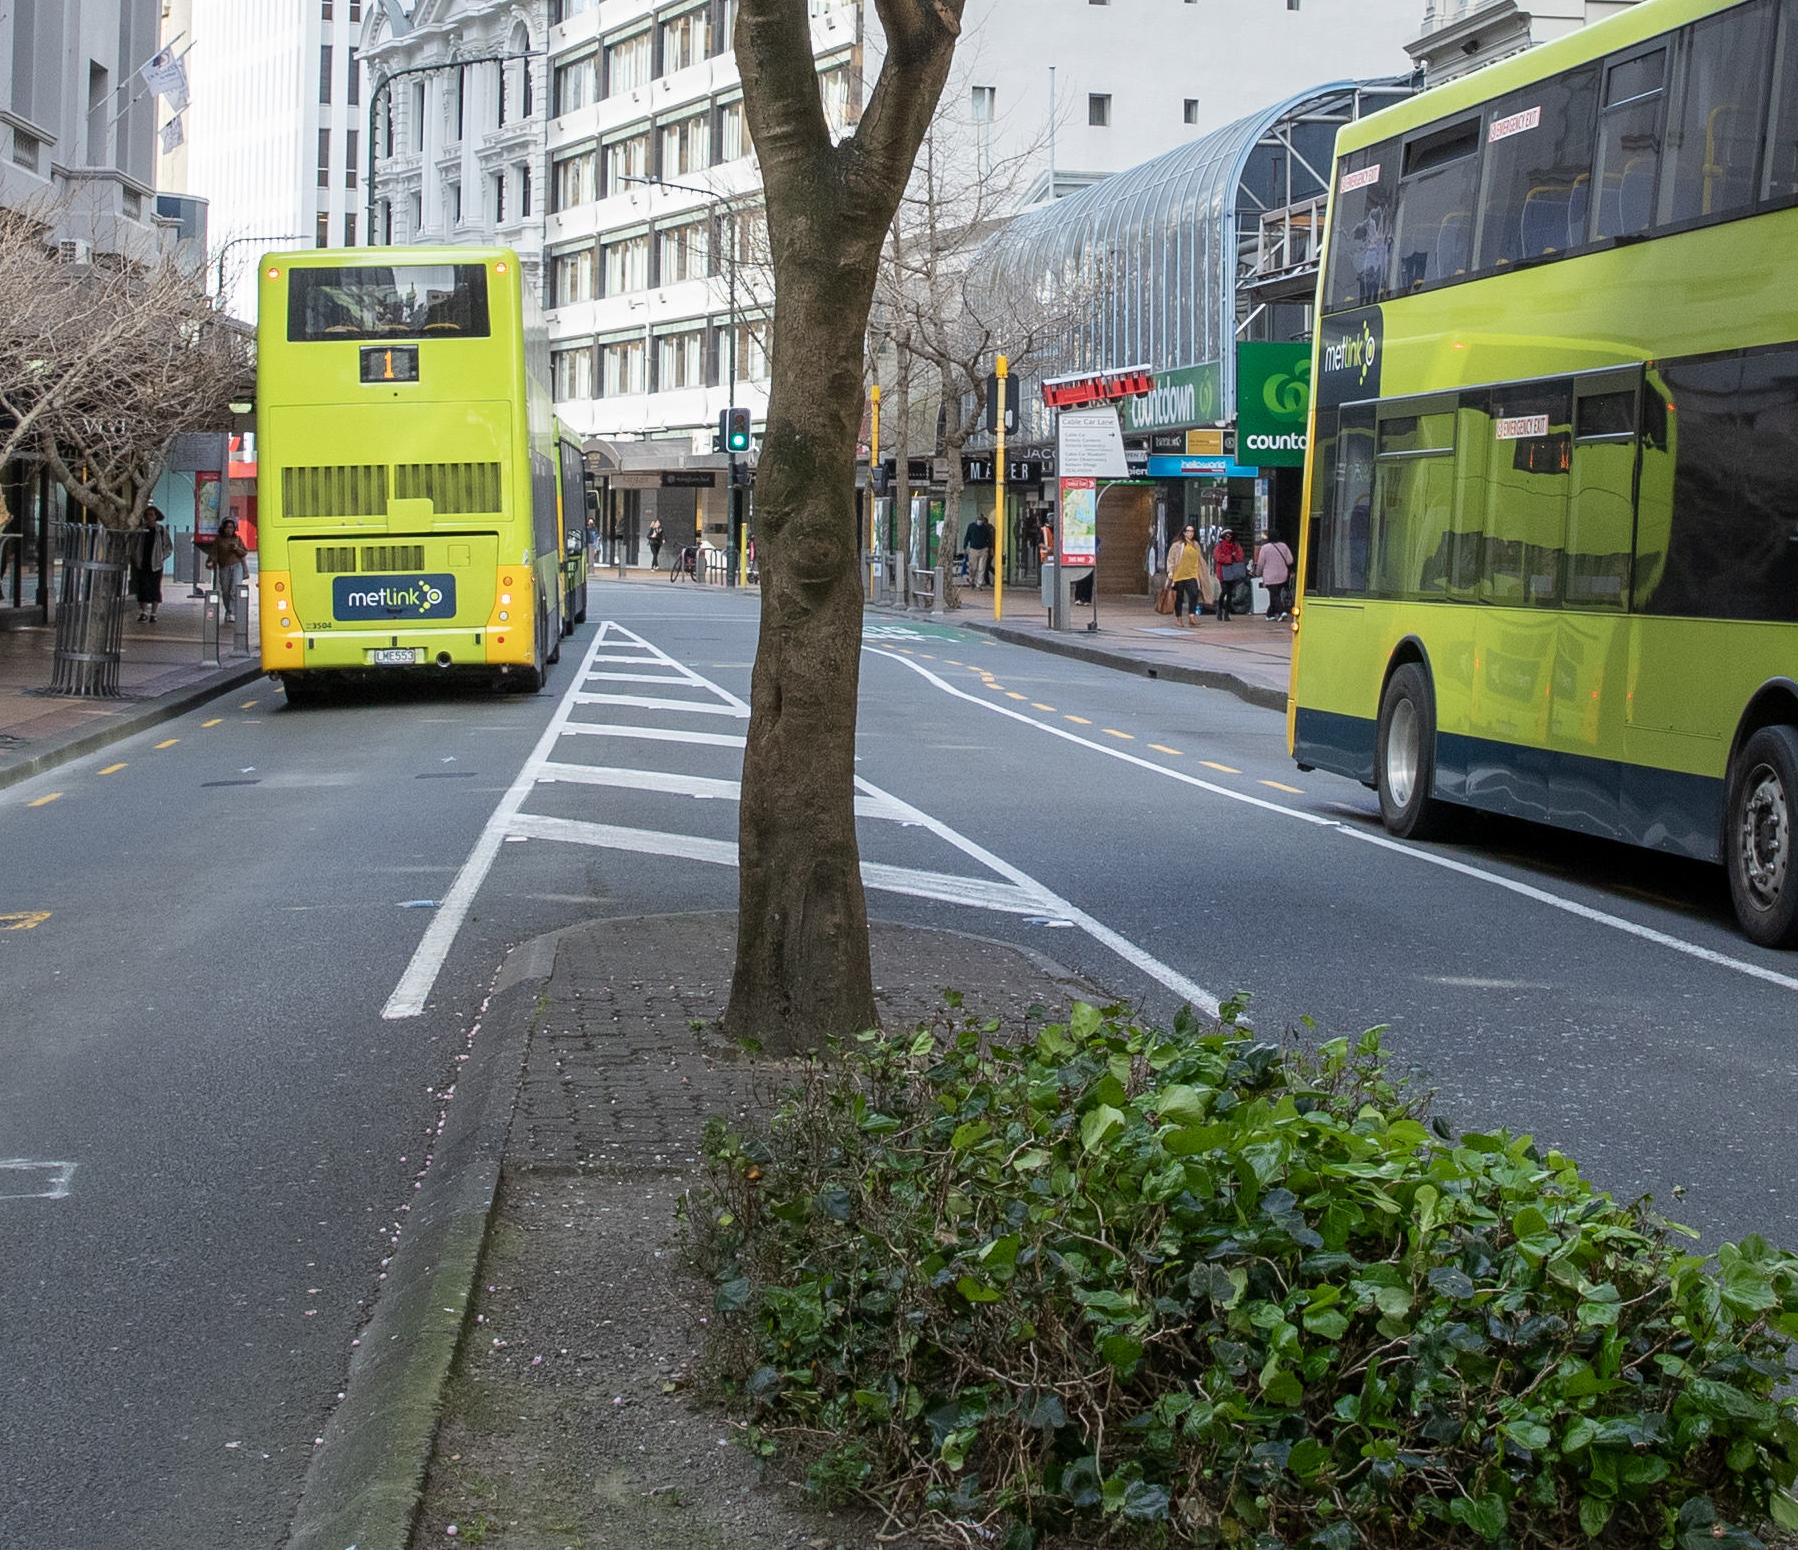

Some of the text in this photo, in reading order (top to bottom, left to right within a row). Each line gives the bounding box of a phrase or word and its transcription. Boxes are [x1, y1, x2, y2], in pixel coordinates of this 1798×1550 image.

[1496, 110, 1537, 137] EMERGENCY EXIT
[384, 349, 394, 380] 1
[1325, 333, 1363, 372] metlink
[1132, 376, 1195, 428] countdown
[1062, 418, 1081, 426] Cable
[1097, 418, 1114, 426] Lane
[1503, 417, 1546, 436] EMERGENCY EXIT
[348, 587, 420, 606] metlink
